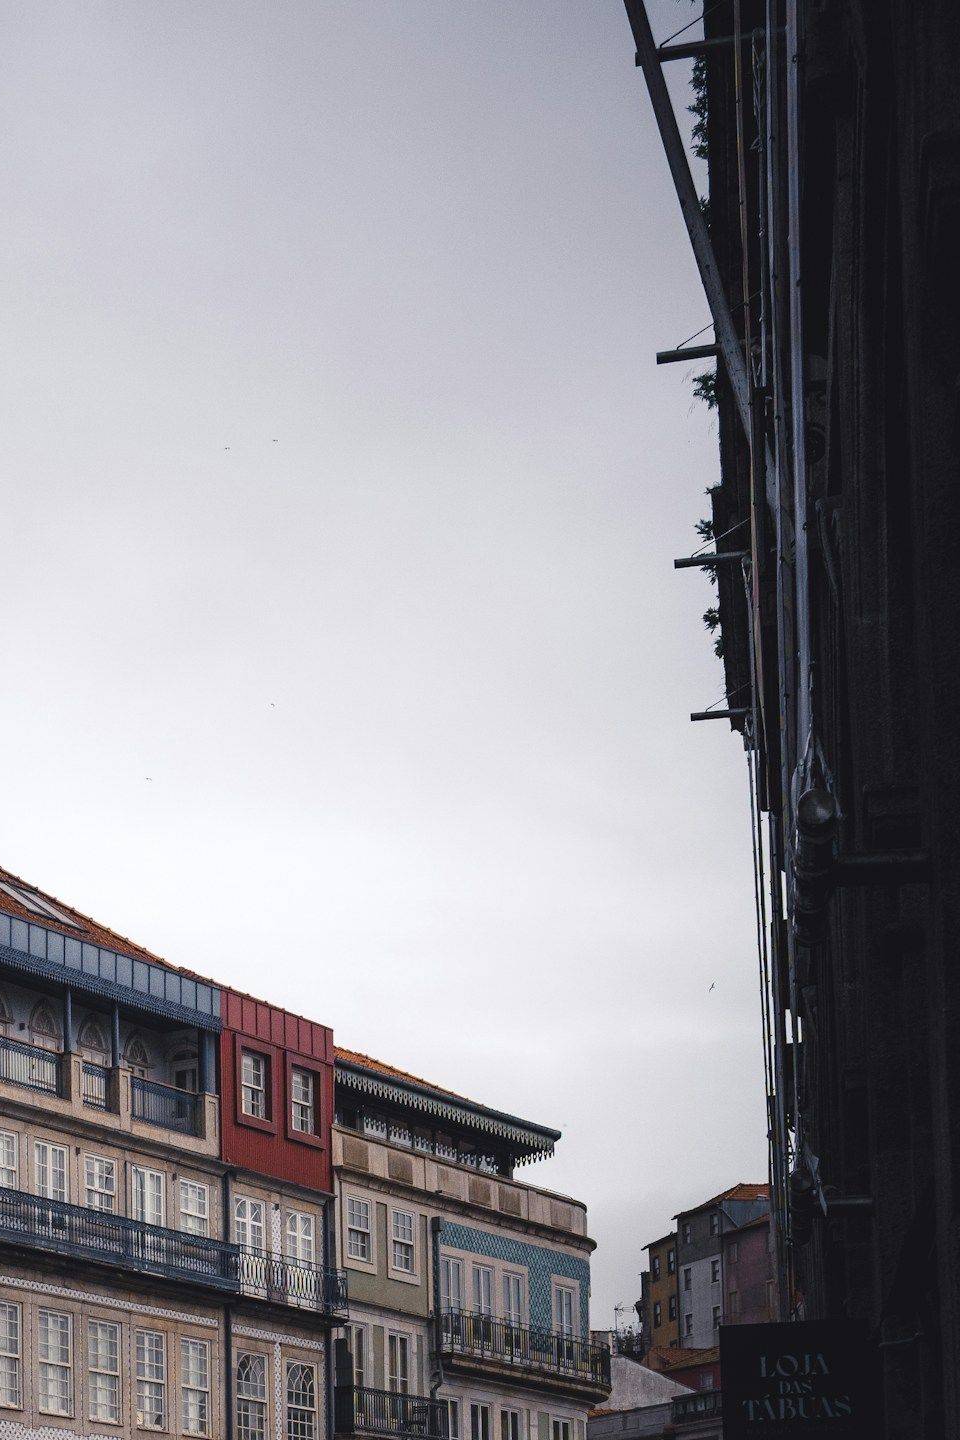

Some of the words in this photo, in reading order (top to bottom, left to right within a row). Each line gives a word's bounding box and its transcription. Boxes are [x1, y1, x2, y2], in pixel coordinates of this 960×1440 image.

[759, 1352, 831, 1378] LOJA
[779, 1380, 813, 1394] DAS
[742, 1394, 853, 1421] TÁBUAS
